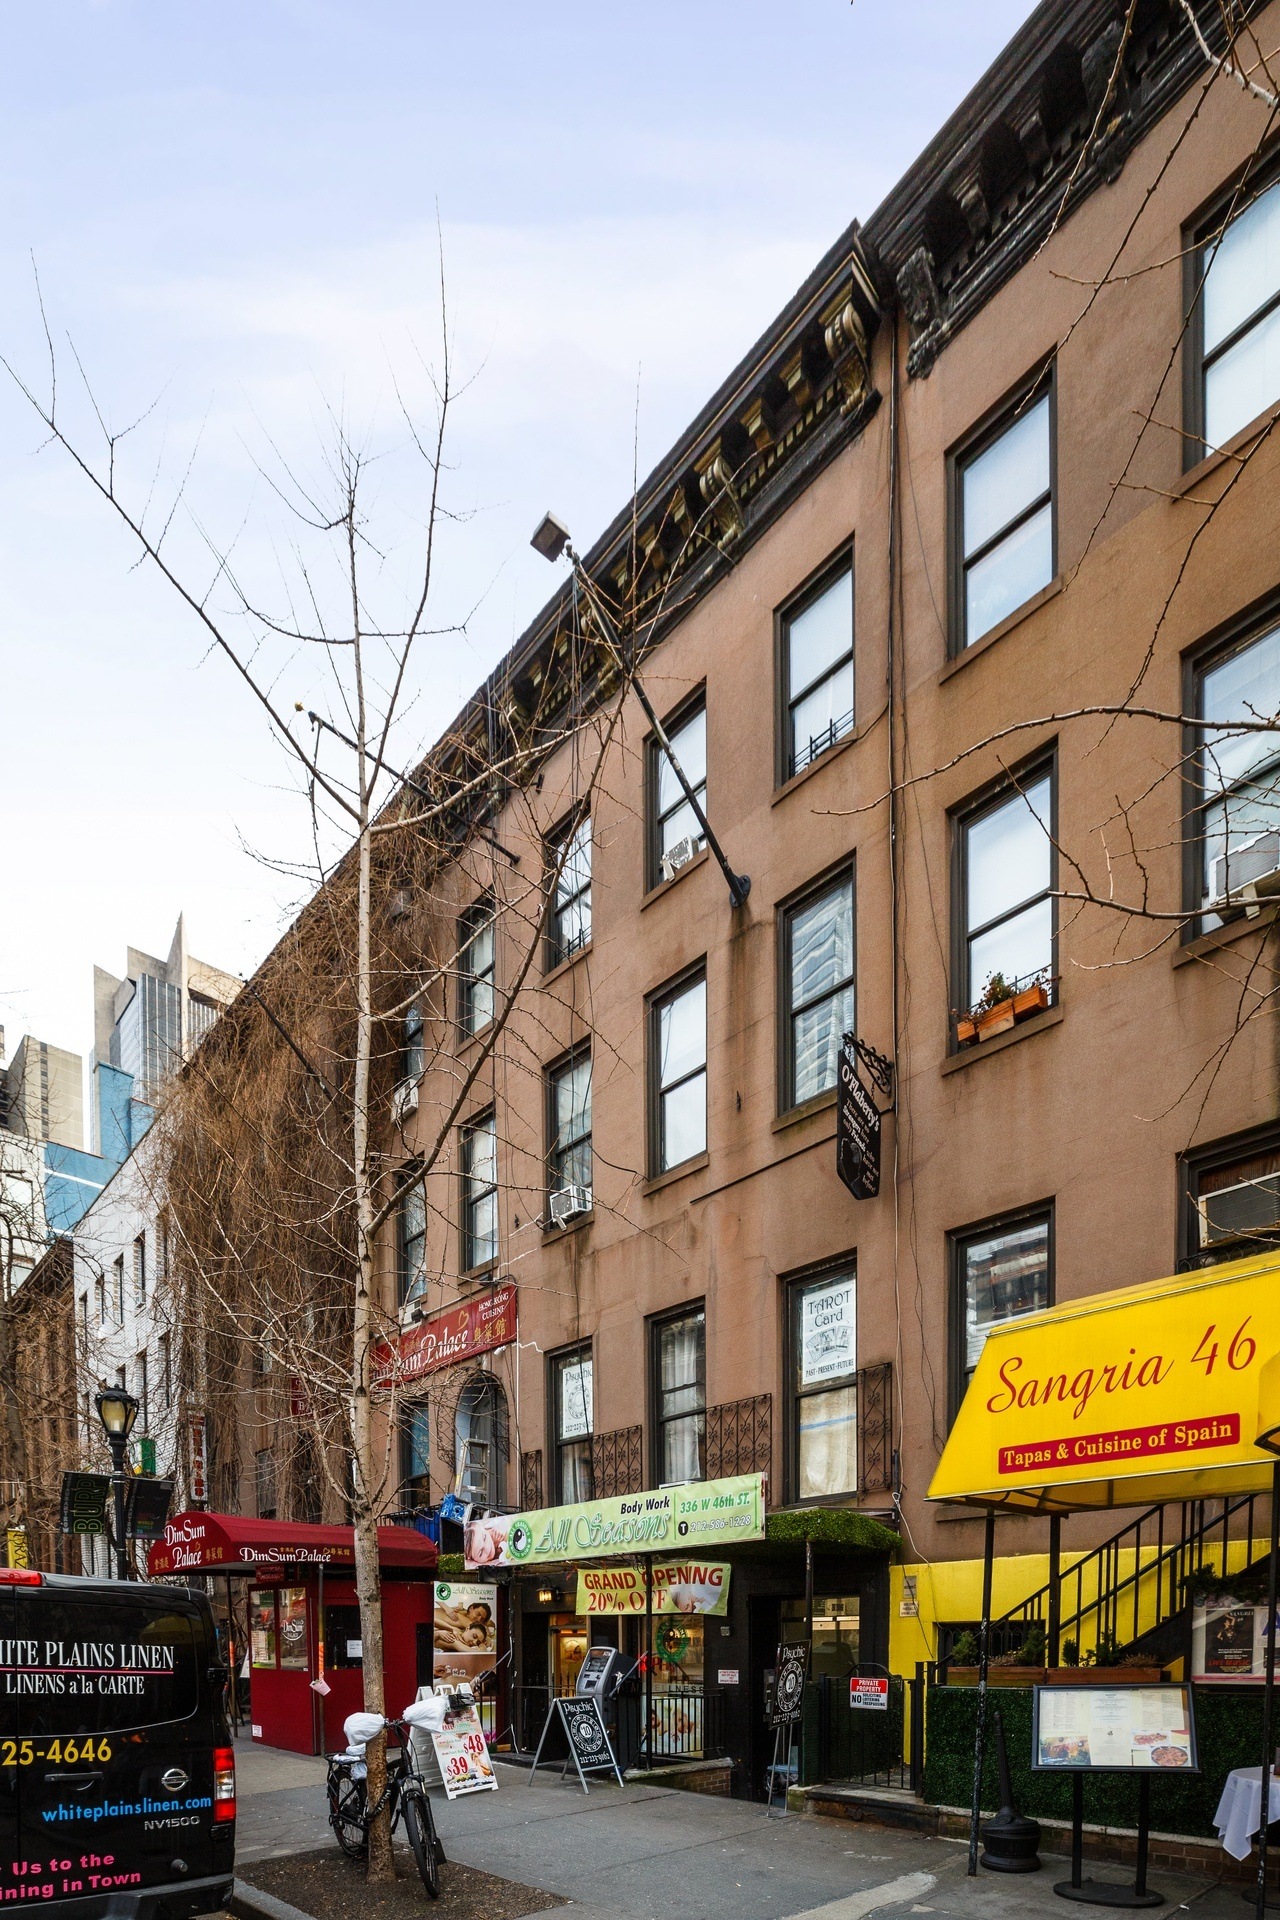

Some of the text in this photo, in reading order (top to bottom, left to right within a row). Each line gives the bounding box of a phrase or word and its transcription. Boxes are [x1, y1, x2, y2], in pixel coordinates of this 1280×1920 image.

[807, 1289, 852, 1314] TAROT
[814, 1308, 843, 1327] Card
[420, 1327, 469, 1365] Palace
[805, 1358, 854, 1378] PAST PRESENT FUTURE
[986, 1315, 1257, 1420] Sangria 46
[1004, 1421, 1232, 1467] Tapas & Cuisine of Spain
[620, 1495, 670, 1516] Body Work
[680, 1492, 750, 1514] 336 W 46th ST.
[534, 1512, 672, 1553] All Seasons
[690, 1515, 751, 1533] 212-586-1228
[172, 1546, 202, 1569] Palace
[584, 1565, 724, 1590] GRAND OPENING
[587, 1592, 625, 1612] 20%
[45, 1641, 116, 1668] PLAINS
[120, 1644, 175, 1670] LINEN
[782, 1645, 806, 1662] Psychic
[5, 1673, 65, 1695] LINENS
[98, 1675, 145, 1695] CARTE
[562, 1701, 594, 1715] Psychic
[851, 1694, 862, 1704] NO
[1, 1738, 112, 1766] 25-4646
[463, 1733, 484, 1754] $48
[447, 1756, 469, 1776] $39
[41, 1796, 212, 1822] whiteplainslinen.com
[144, 1815, 200, 1830] NV1500
[12, 1854, 115, 1876] Us to the
[63, 1879, 82, 1892] in
[88, 1872, 141, 1889] Town
